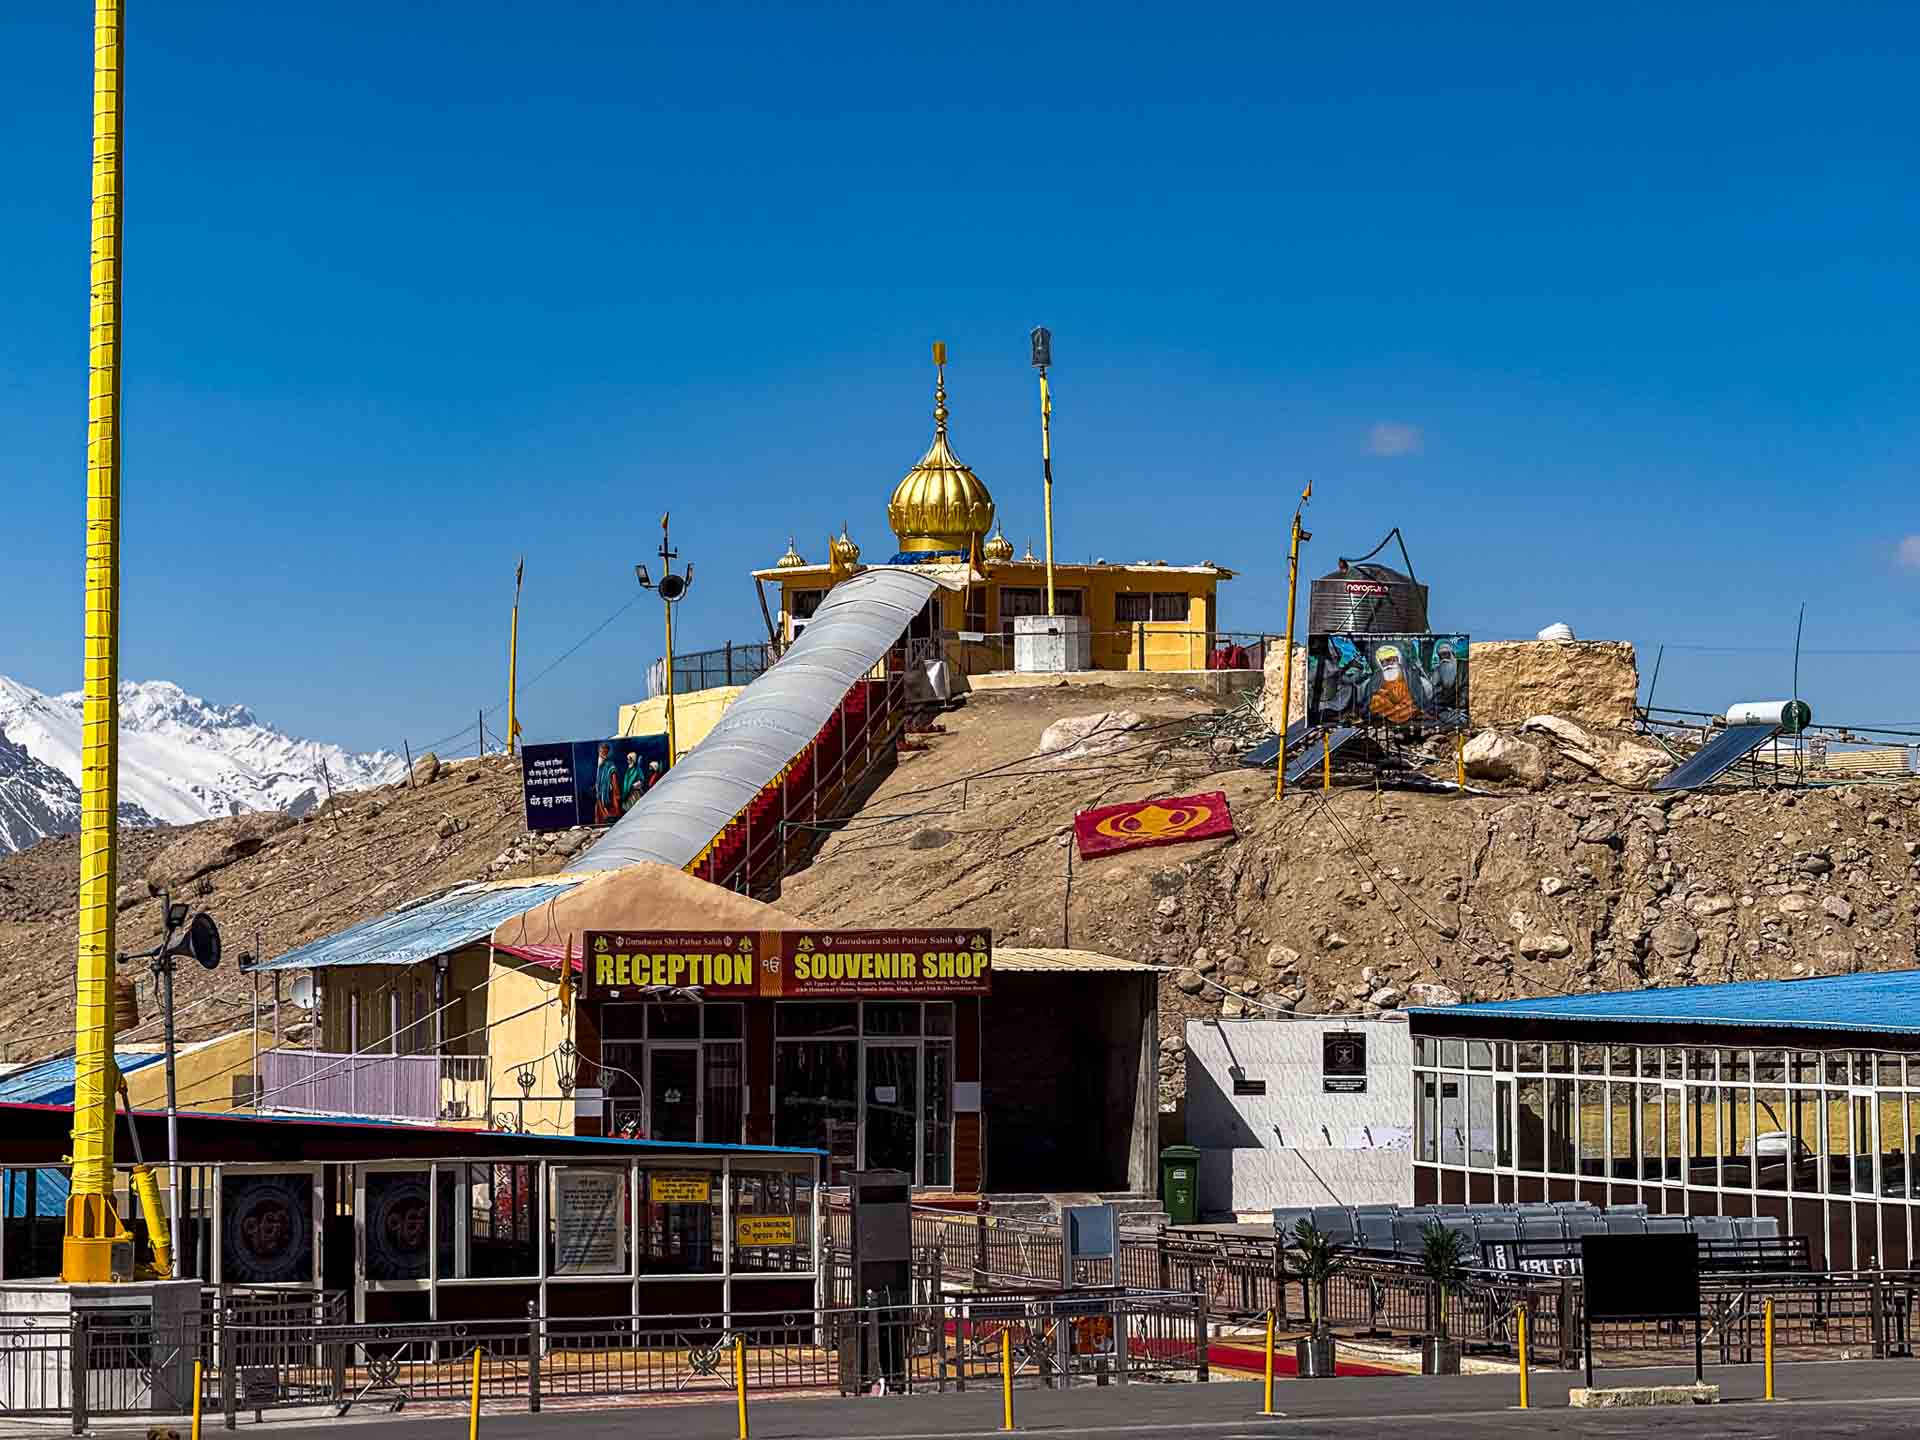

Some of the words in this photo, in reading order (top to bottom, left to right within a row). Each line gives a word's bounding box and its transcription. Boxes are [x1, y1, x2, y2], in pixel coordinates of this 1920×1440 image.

[664, 936, 678, 945] Shri
[836, 936, 881, 946] Gurudwara
[882, 936, 900, 945] Shri
[930, 936, 953, 945] Sahib
[595, 953, 752, 985] RECEPTION
[794, 952, 916, 979] SOUVENIR
[921, 951, 988, 978] SHOP
